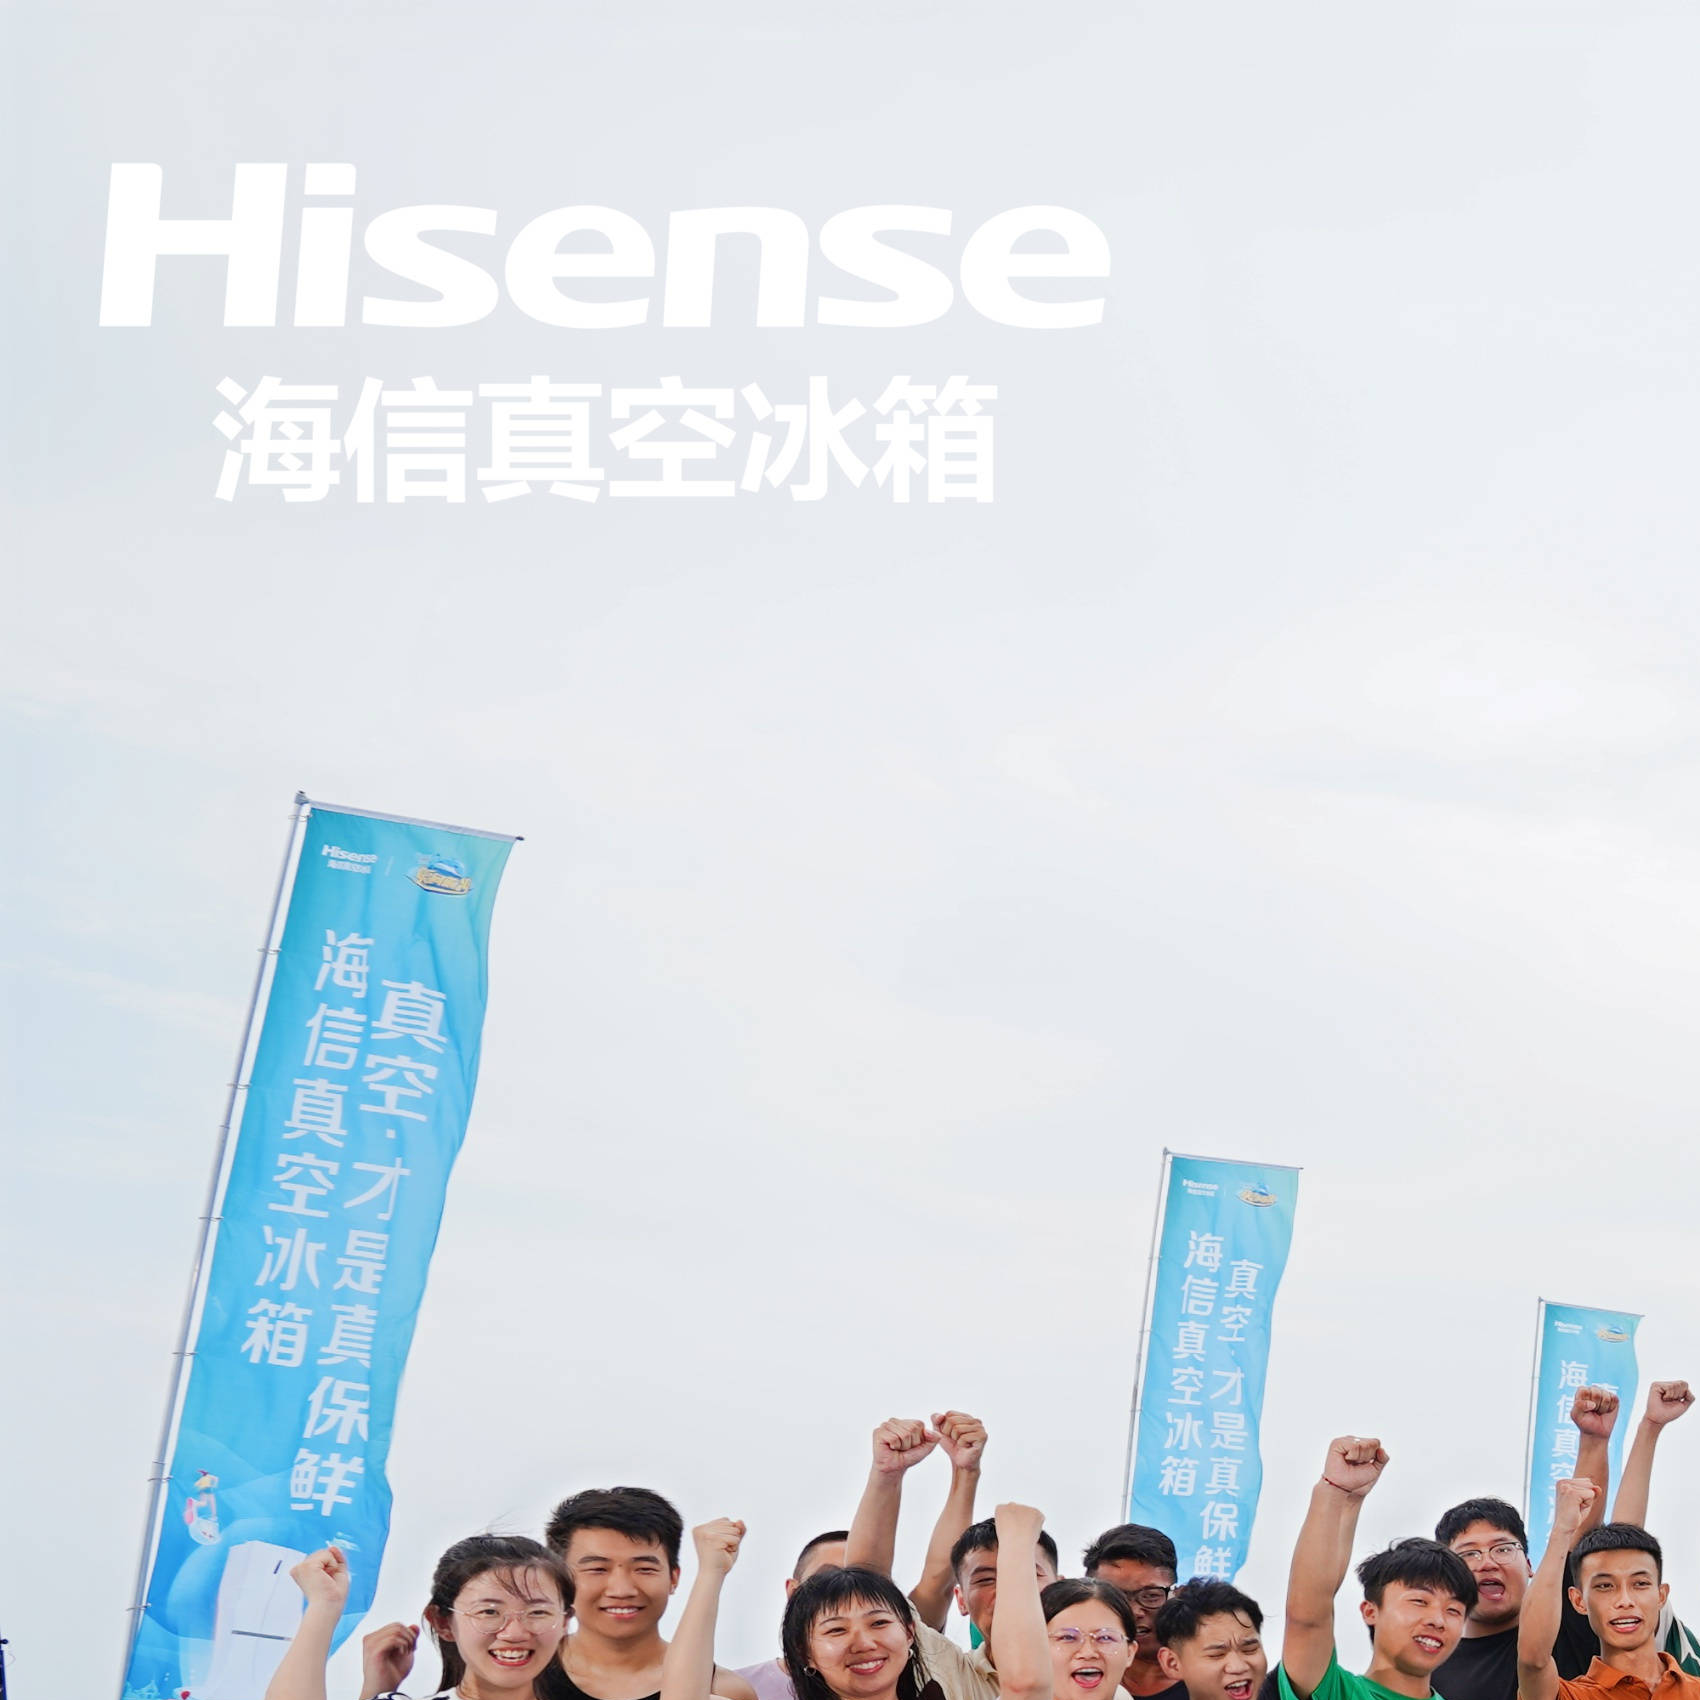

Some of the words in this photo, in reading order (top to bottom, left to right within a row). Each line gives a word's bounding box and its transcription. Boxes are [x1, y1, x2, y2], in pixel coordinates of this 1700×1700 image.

[241, 928, 374, 1368] 海信真空冰箱
[1158, 1229, 1225, 1498] 海信真空冰箱
